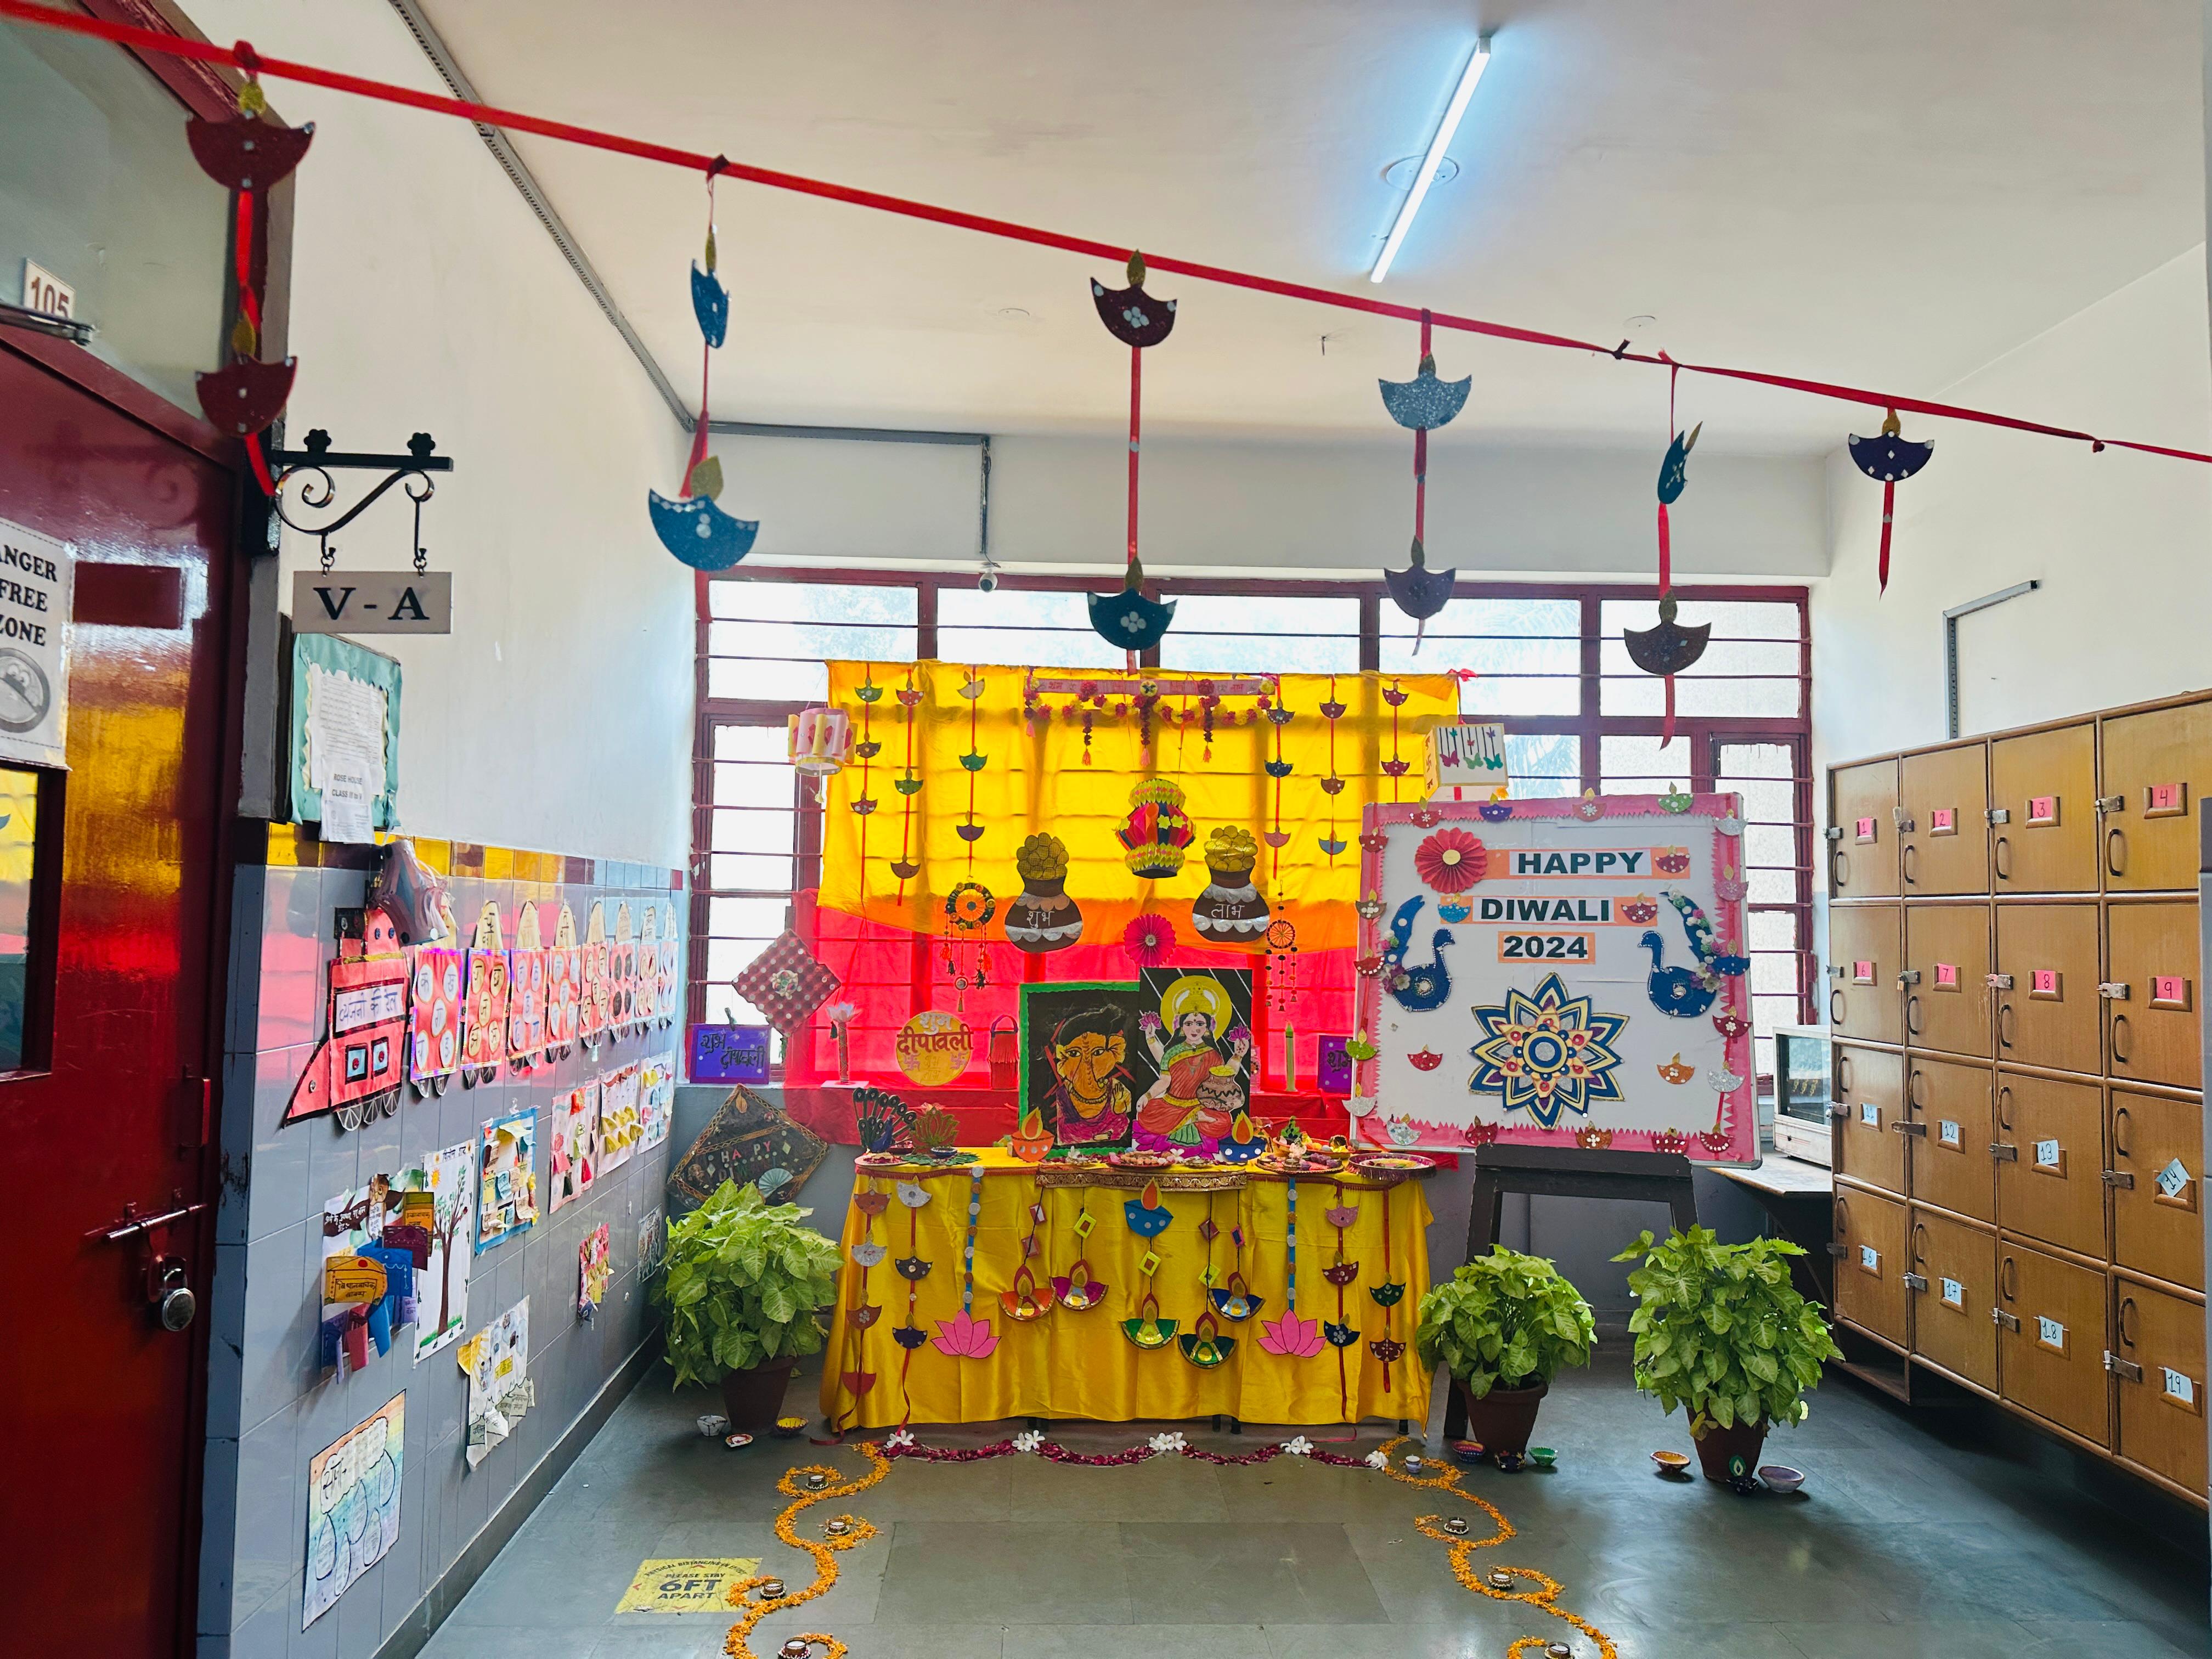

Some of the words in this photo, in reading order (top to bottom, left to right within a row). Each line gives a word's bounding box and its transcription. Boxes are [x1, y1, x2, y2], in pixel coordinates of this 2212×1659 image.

[0, 544, 57, 582] NGER
[0, 578, 48, 612] FREE
[333, 774, 347, 782] ROSE
[332, 789, 348, 798] CLASS
[2160, 790, 2168, 806] 4
[2038, 802, 2045, 817] 3
[1862, 822, 1866, 833] 1
[1940, 813, 1945, 826] 2
[1518, 852, 1644, 874] HAPPY
[1211, 903, 1245, 918] लाभ
[1481, 899, 1610, 922] DIWALI
[1026, 911, 1055, 929] शुभ
[1503, 936, 1588, 958] 2024
[1861, 964, 1865, 975] 6
[1943, 968, 1949, 981] 7
[2044, 974, 2050, 989] 8
[2164, 982, 2172, 998] 9
[919, 1013, 952, 1035] शुभ
[701, 1032, 726, 1054] शुभ
[896, 1024, 974, 1055] दीपावली
[720, 1045, 765, 1070] दीपावली
[1865, 1104, 1874, 1118] 11
[1945, 1125, 1955, 1138] 12
[2040, 1143, 2052, 1160] 13
[2164, 1171, 2180, 1190] 14
[1946, 1283, 1957, 1296] 17
[2042, 1323, 2056, 1339] 18
[2168, 1373, 2181, 1393] 19
[645, 1564, 676, 1576] PHYSICAL
